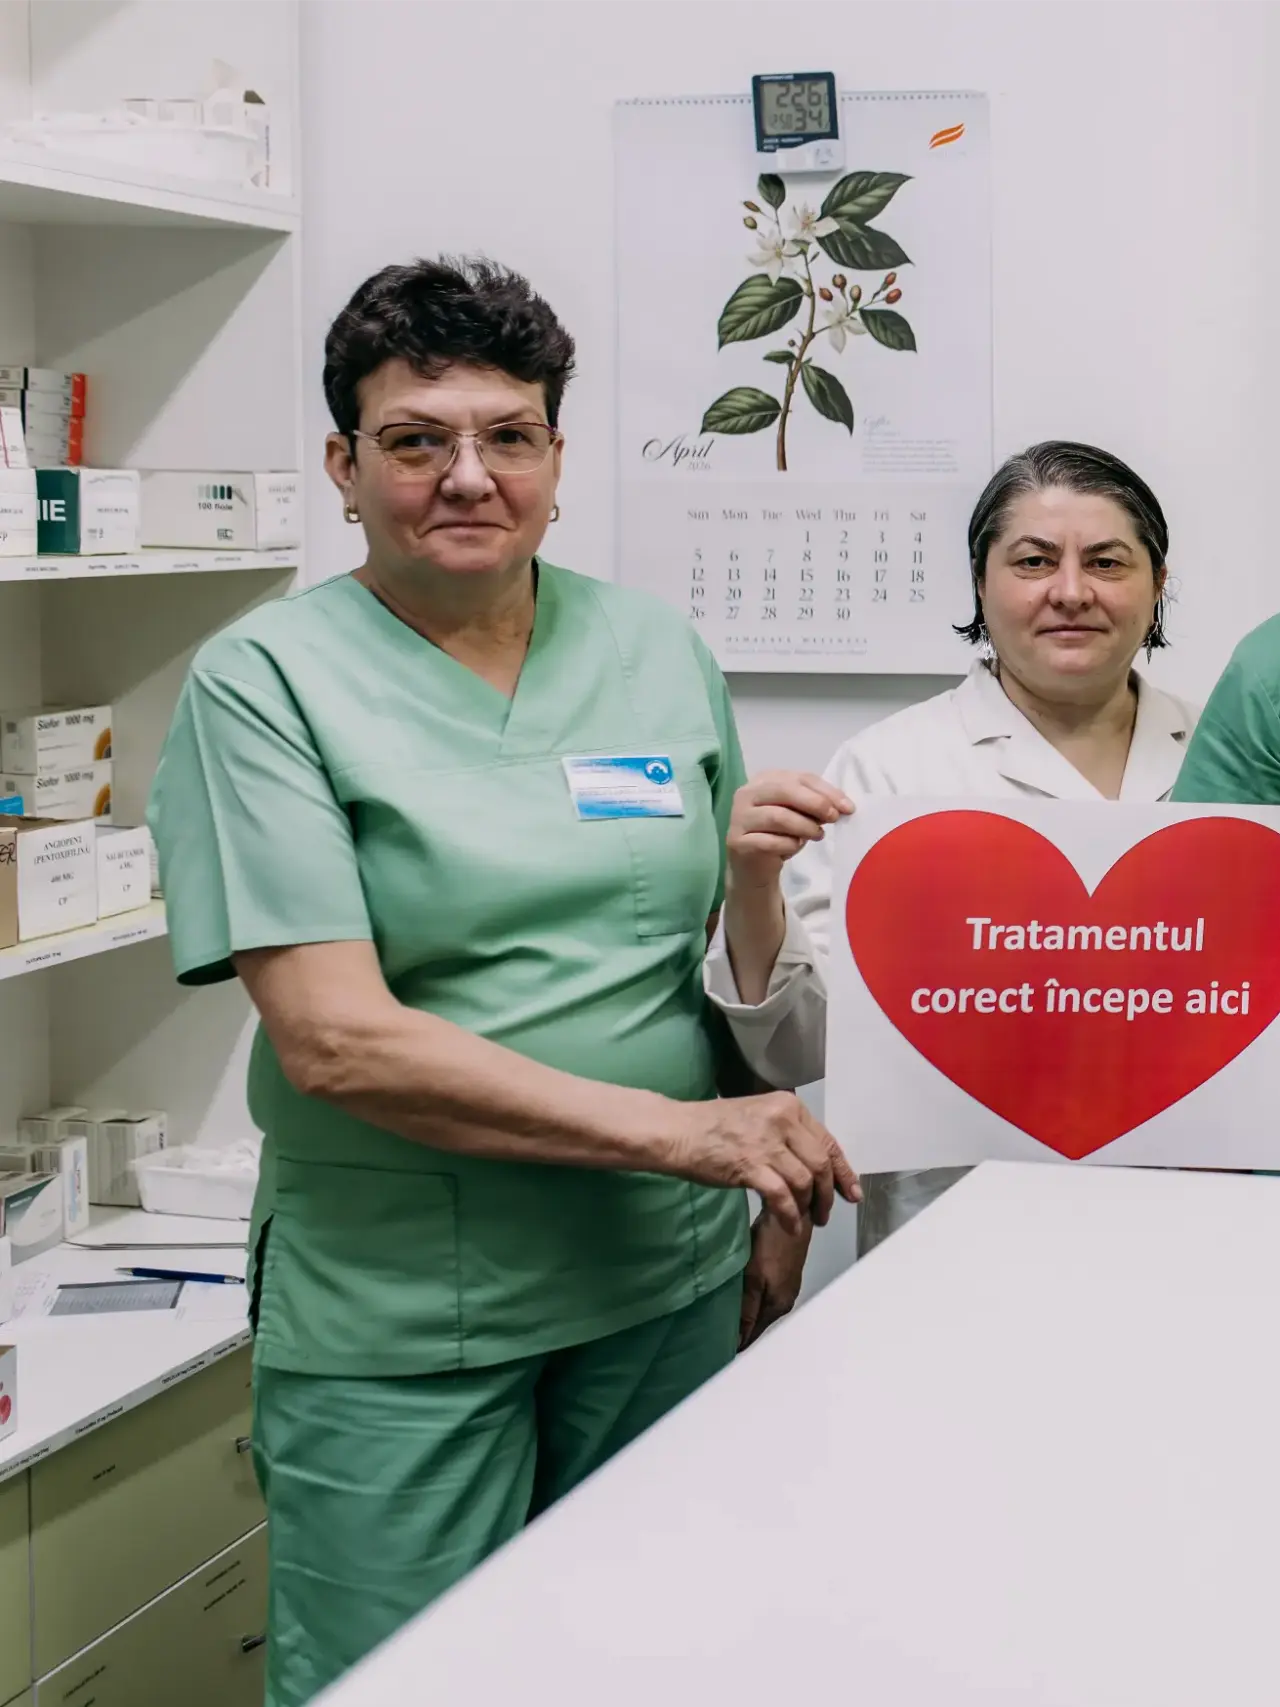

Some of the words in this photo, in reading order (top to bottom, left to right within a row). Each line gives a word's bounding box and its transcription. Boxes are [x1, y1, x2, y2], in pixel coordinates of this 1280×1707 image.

[642, 437, 715, 467] April
[687, 509, 710, 521] Sun
[722, 508, 749, 521] Mon
[762, 509, 783, 521] Tue
[795, 508, 822, 521] Wed
[833, 508, 857, 522] Thu
[873, 510, 890, 522] Fri
[909, 511, 927, 522] Sat
[804, 530, 811, 544] 1
[839, 530, 849, 544] 2
[878, 530, 886, 545] 3
[913, 532, 922, 544] 4
[694, 548, 703, 561] 5
[729, 550, 739, 561] 6
[767, 549, 775, 563] 7
[802, 550, 812, 562] 8
[838, 550, 849, 562] 9
[873, 550, 889, 563] 10
[912, 551, 923, 564] 11
[691, 568, 705, 581] 12
[727, 568, 741, 581] 13
[763, 568, 777, 582] 14
[800, 569, 814, 582] 15
[836, 569, 851, 582] 16
[874, 569, 888, 583] 17
[911, 569, 925, 583] 18
[690, 586, 705, 600] 19
[725, 587, 742, 601] 20
[762, 587, 776, 601] 21
[798, 588, 815, 601] 22
[834, 588, 851, 601] 23
[871, 588, 888, 602] 24
[909, 589, 926, 602] 25
[689, 606, 707, 620] 26
[725, 606, 740, 619] 27
[760, 606, 777, 620] 28
[796, 607, 814, 620] 29
[836, 608, 851, 620] 30
[966, 917, 1205, 952] Tratamentul
[910, 982, 1034, 1014] corect
[1043, 978, 1174, 1021] începe
[1185, 981, 1251, 1016] aici
